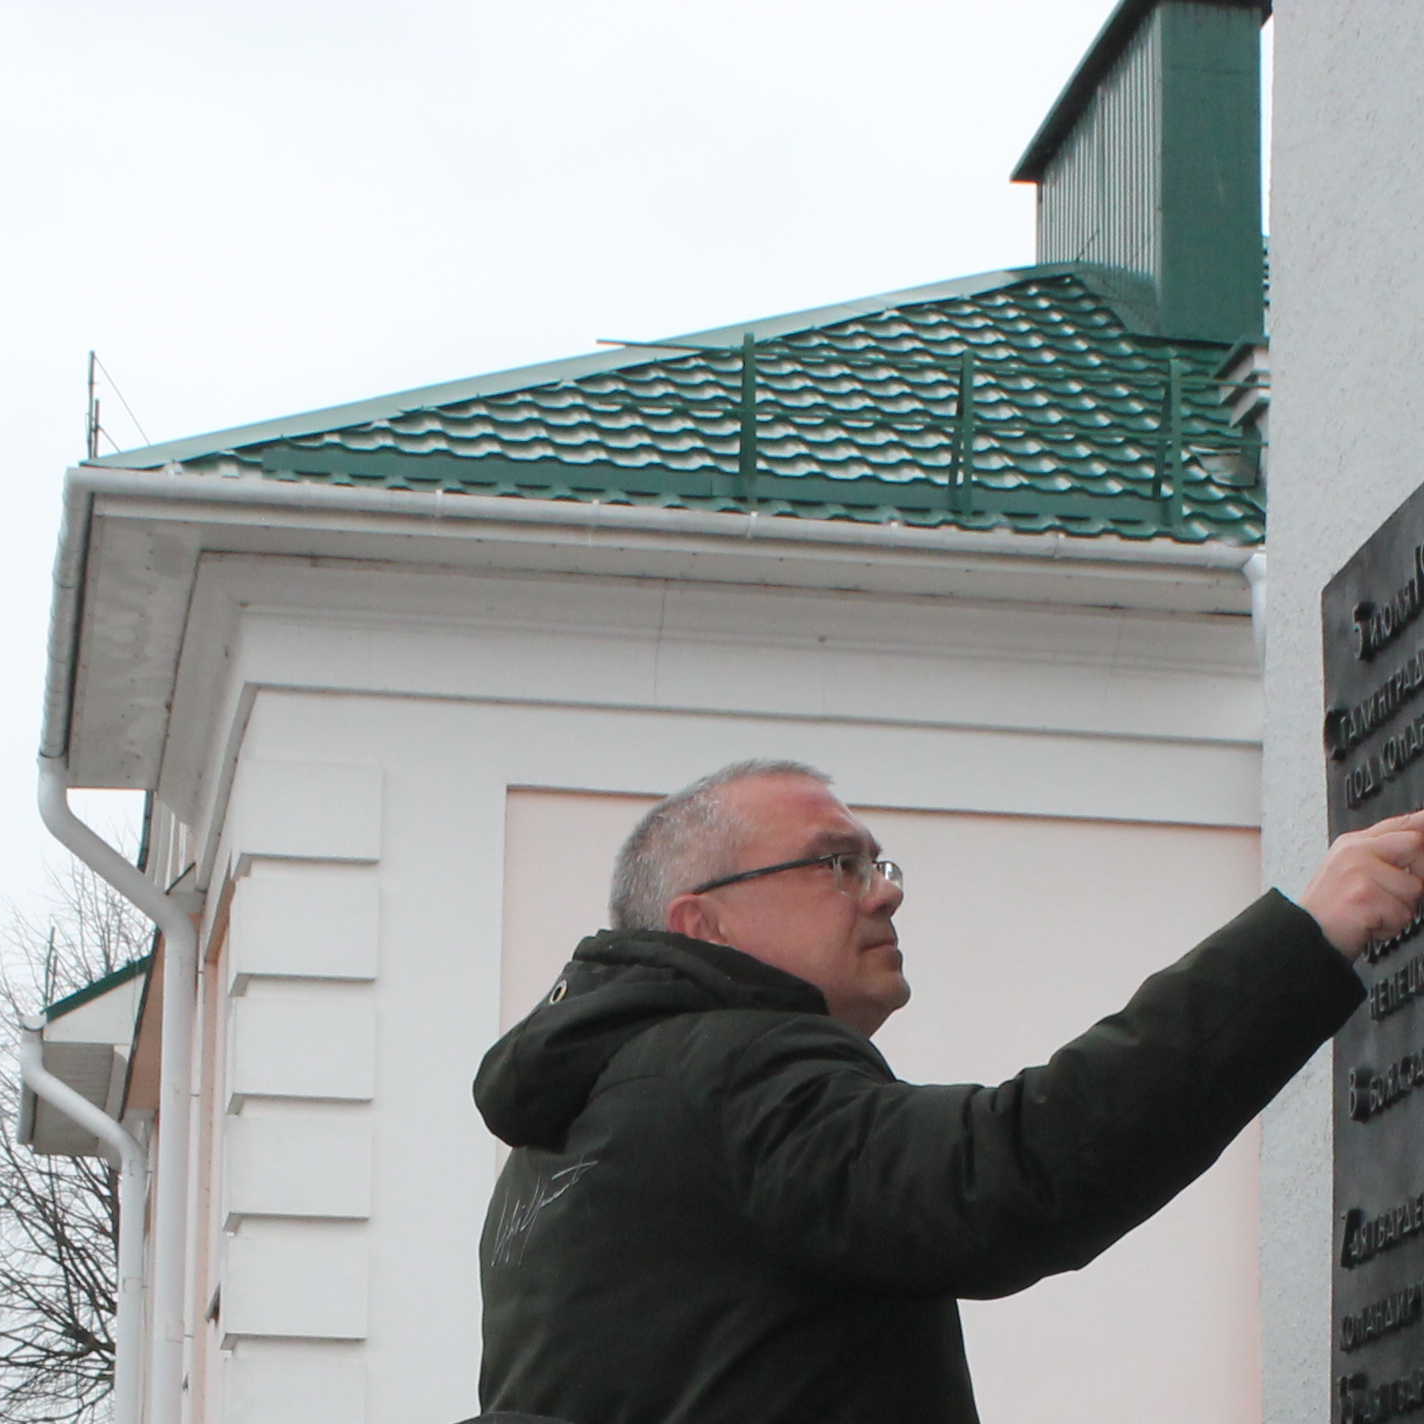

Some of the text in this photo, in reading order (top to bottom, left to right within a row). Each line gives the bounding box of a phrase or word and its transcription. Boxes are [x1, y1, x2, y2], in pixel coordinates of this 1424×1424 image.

[1351, 598, 1362, 664] 5
[1344, 753, 1374, 809] ПОД
[1348, 1063, 1358, 1119] В
